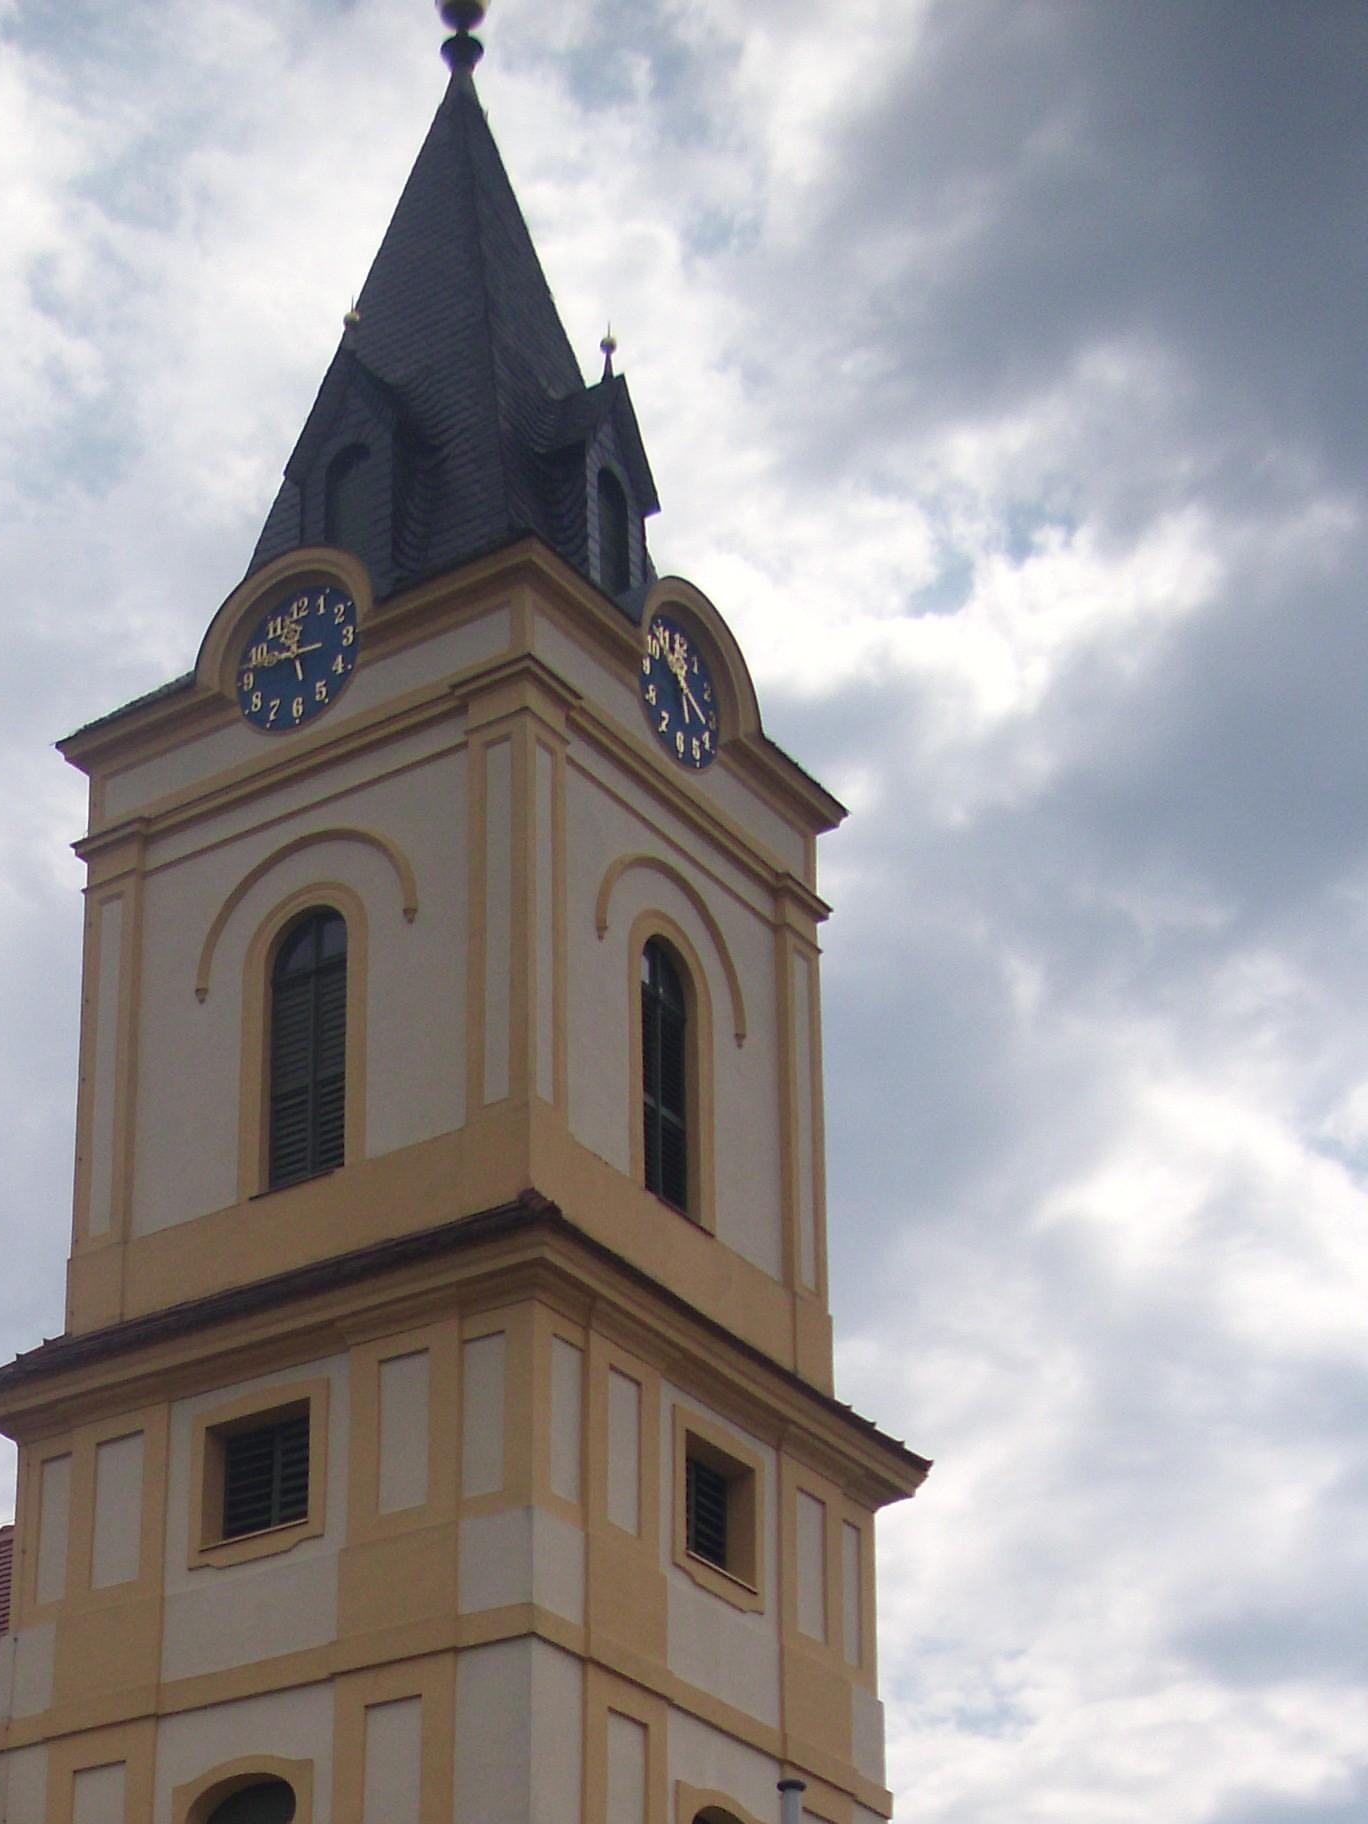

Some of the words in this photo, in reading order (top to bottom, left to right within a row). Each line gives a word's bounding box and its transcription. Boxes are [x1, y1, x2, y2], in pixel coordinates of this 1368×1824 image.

[290, 597, 309, 620] 12
[316, 595, 325, 615] 1
[334, 604, 345, 624] 2
[268, 617, 283, 639] 11
[342, 626, 354, 646] 3
[250, 643, 267, 667] 10
[648, 635, 660, 659] 10
[332, 655, 344, 674] 4
[244, 672, 253, 691] 9
[315, 681, 326, 701] 5
[251, 692, 261, 712] 8
[270, 699, 280, 721] 7
[292, 697, 303, 717] 6
